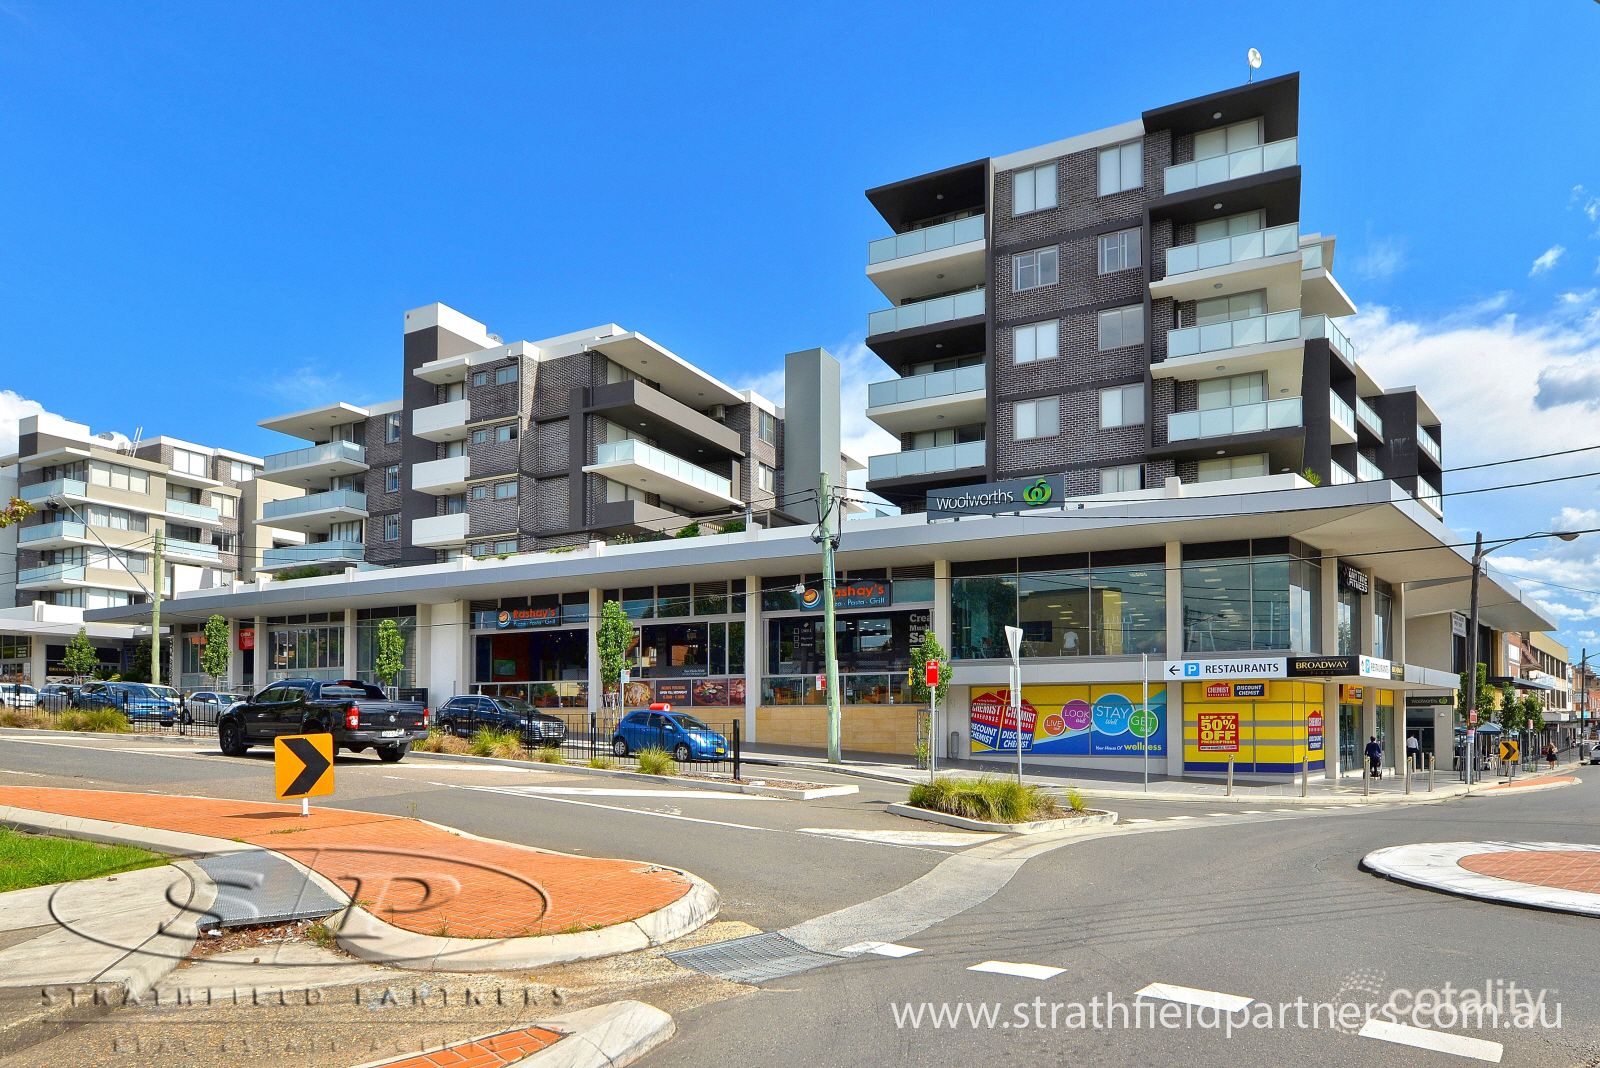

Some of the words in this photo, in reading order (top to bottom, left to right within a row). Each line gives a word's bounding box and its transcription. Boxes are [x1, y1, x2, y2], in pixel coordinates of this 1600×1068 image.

[834, 583, 885, 598] ashay's
[869, 597, 885, 605] Grill
[512, 608, 556, 619] Rashay's
[1205, 663, 1279, 674] RESTAURANTS
[1295, 660, 1349, 670] BROADWAY
[1207, 686, 1229, 694] CHEMIST
[1064, 709, 1090, 719] LOOK
[1096, 705, 1130, 719] STAY
[1046, 719, 1062, 728] LIVE
[1130, 715, 1155, 726] GET
[1200, 719, 1236, 731] 50%
[1001, 730, 1033, 741] DISCUNT
[1200, 730, 1236, 741] OFF
